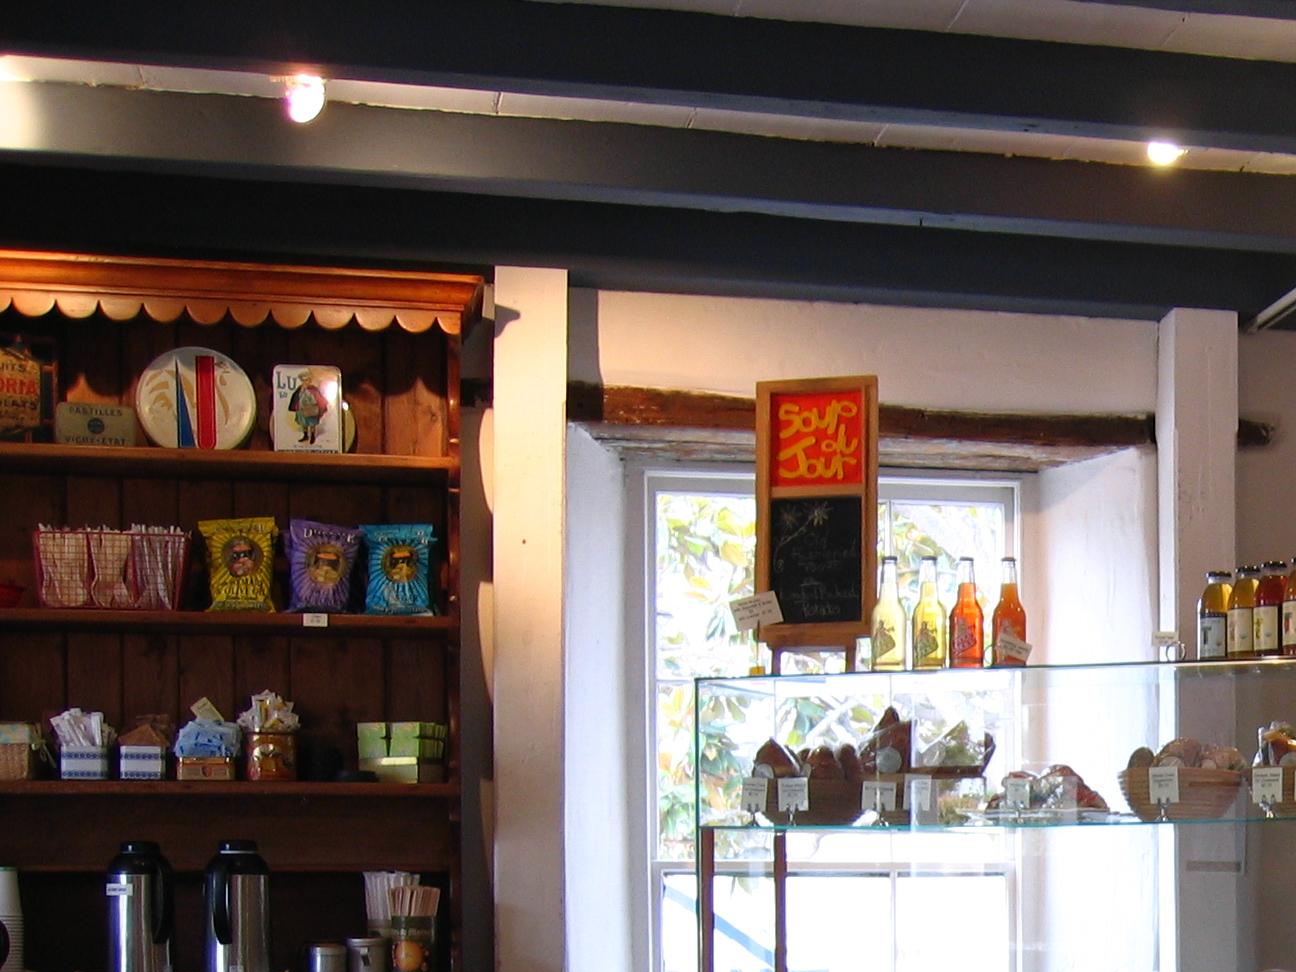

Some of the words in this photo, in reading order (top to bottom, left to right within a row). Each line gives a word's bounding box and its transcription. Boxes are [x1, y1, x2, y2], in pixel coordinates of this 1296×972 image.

[276, 371, 297, 390] LU
[778, 399, 858, 439] Soup
[821, 425, 859, 455] du
[777, 436, 858, 480] Jour
